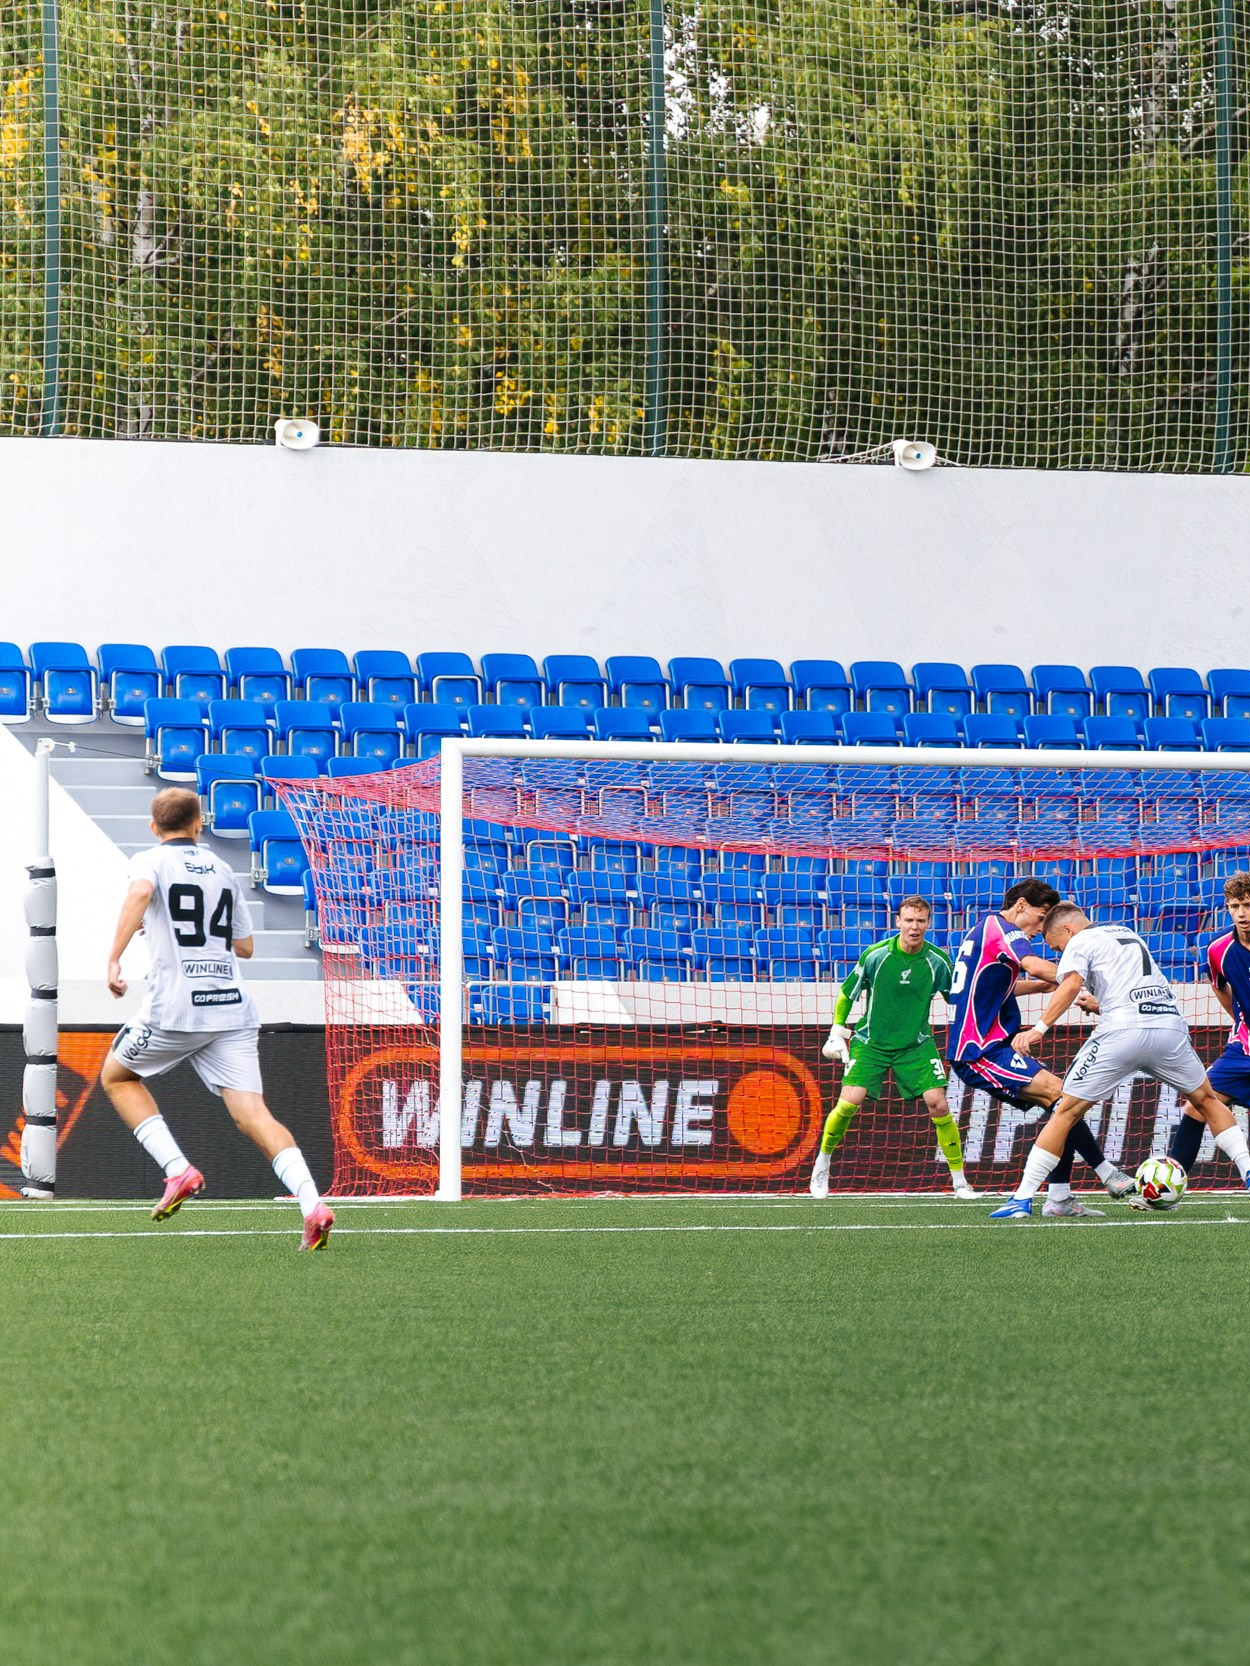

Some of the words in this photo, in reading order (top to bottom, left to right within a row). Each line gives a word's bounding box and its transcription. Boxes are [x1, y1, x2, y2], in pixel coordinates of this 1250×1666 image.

[168, 883, 232, 951] 94
[184, 963, 229, 975] WINLINE
[1116, 938, 1152, 976] 7
[1072, 1040, 1101, 1081] Vorgol
[381, 1080, 719, 1147] WINLINE
